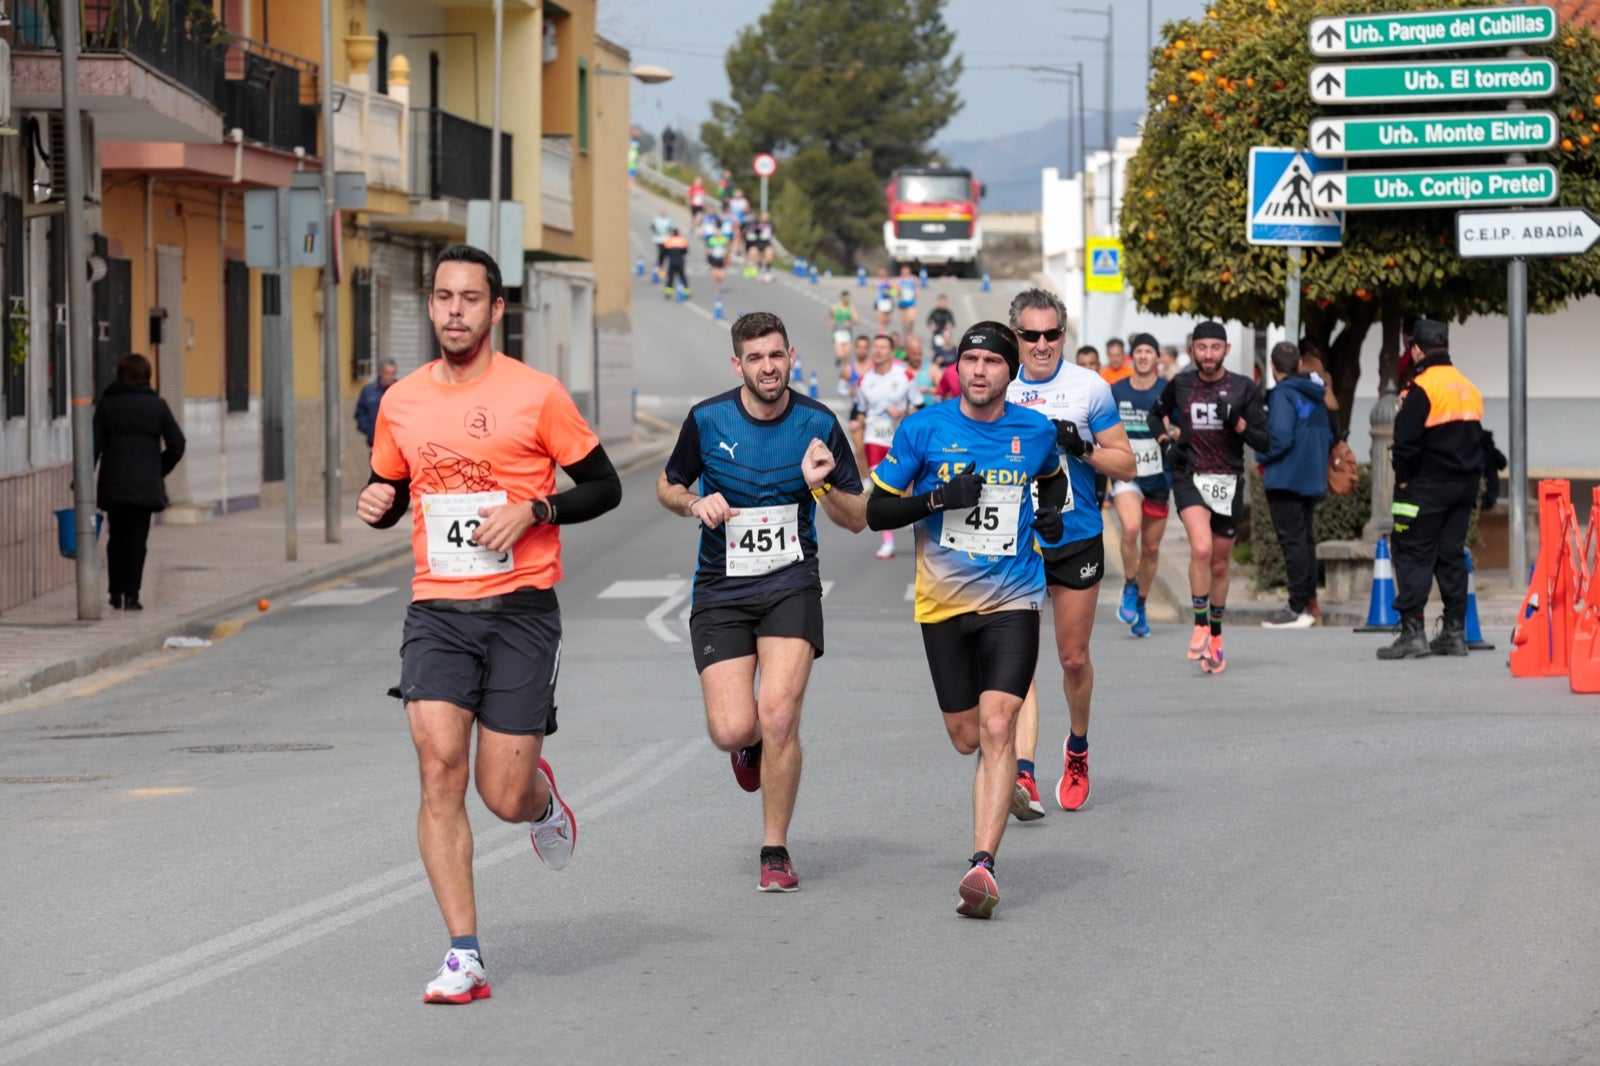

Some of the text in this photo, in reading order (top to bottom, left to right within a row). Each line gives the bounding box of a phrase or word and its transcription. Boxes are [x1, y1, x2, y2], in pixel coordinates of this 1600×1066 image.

[1349, 14, 1545, 43] Urb. Parque del Cubillas
[1404, 67, 1545, 90] Urb. El torreón
[1378, 120, 1544, 144] Urb. Monte Elvira
[1374, 173, 1546, 200] Urb. Cortijo Pretel
[1464, 222, 1584, 242] C.E.I.P. ABADÍA
[979, 468, 1028, 486] EDIA
[965, 506, 999, 531] 45
[739, 526, 786, 553] 451
